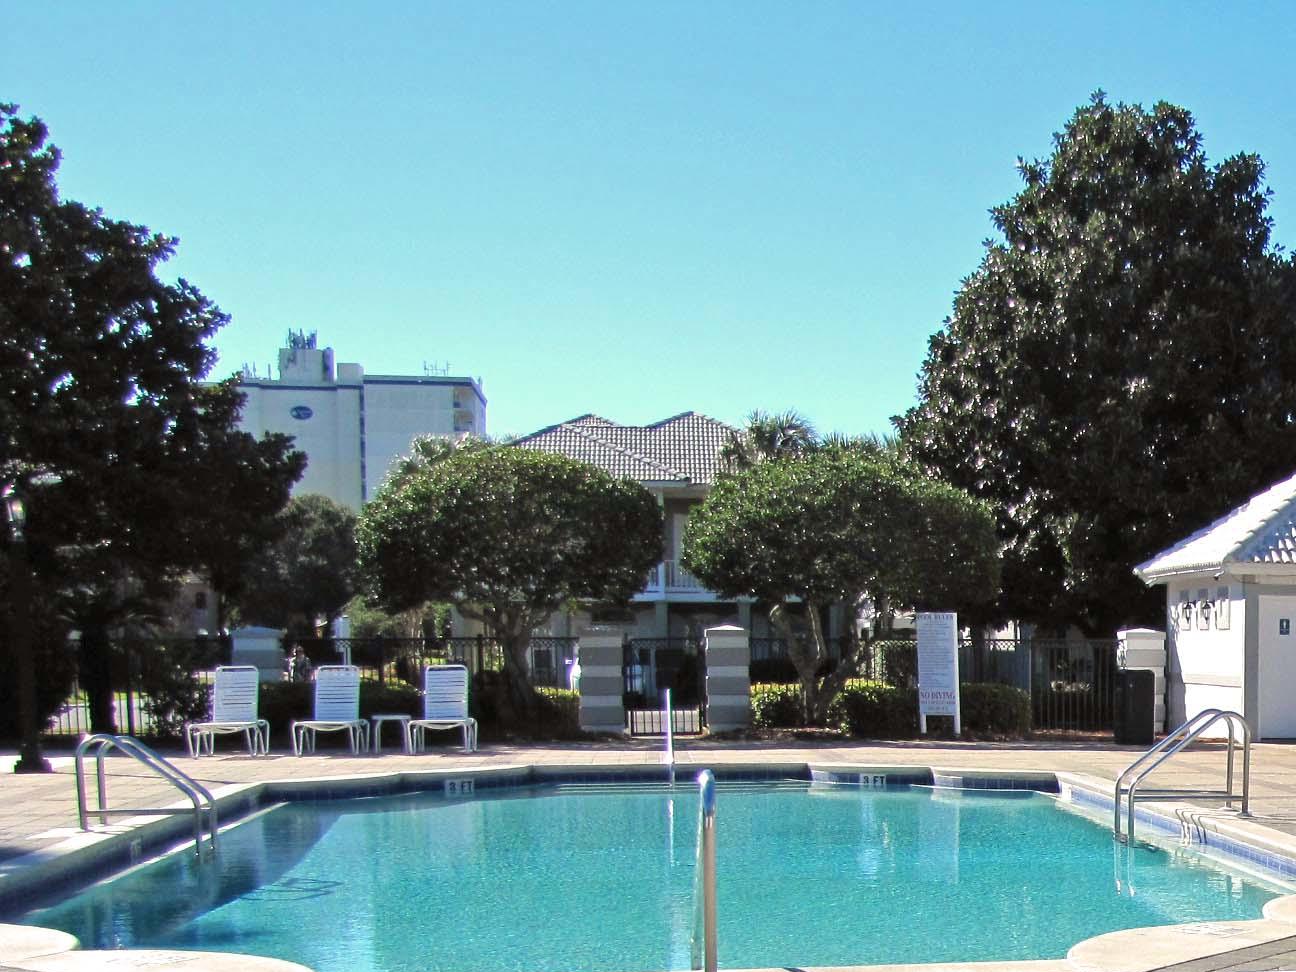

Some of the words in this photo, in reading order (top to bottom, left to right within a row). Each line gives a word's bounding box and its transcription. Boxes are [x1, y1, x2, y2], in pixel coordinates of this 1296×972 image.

[920, 691, 930, 699] NO
[931, 691, 956, 700] DIVING
[863, 775, 870, 785] 3
[873, 775, 885, 785] FT
[449, 782, 457, 793] 3
[460, 781, 472, 793] FT
